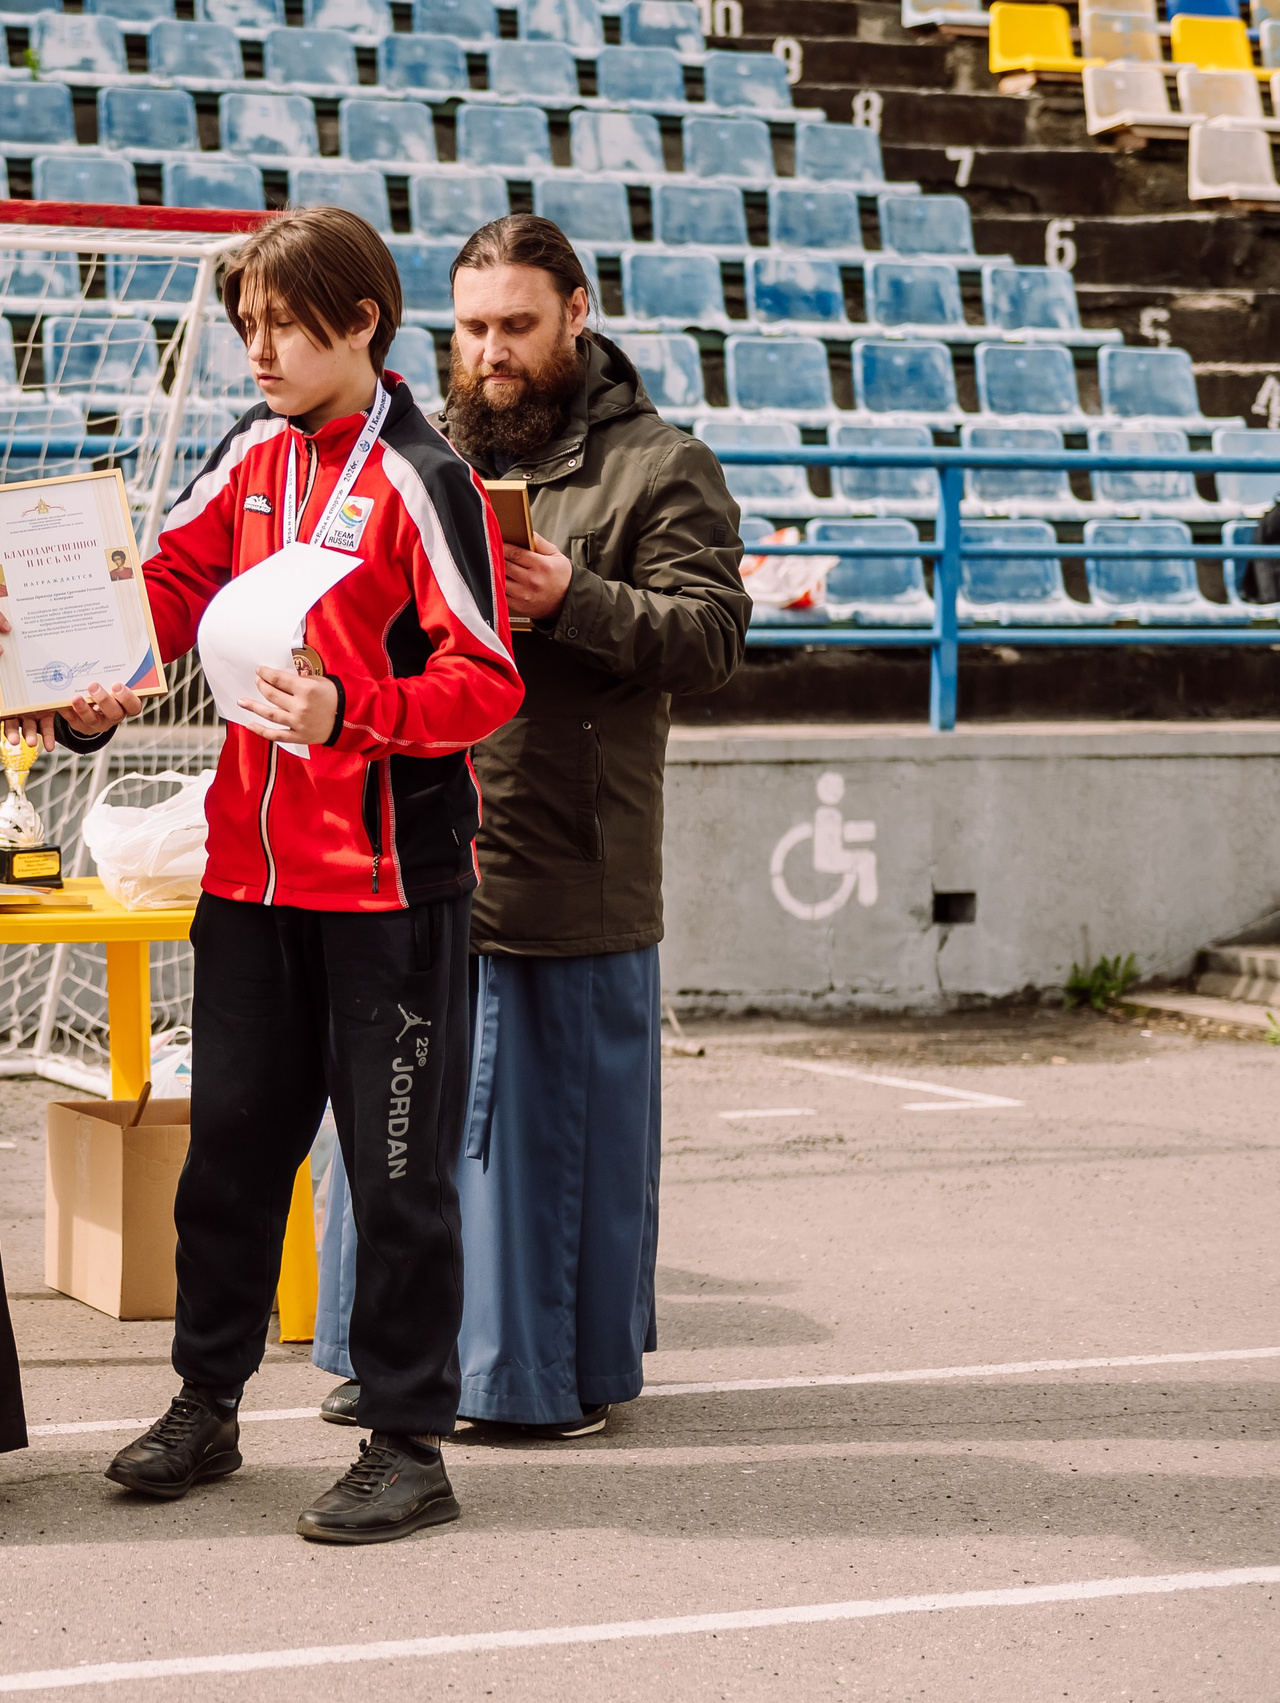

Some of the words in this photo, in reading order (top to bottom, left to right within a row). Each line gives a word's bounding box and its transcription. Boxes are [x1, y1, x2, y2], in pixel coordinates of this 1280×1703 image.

[698, 0, 743, 37] 10
[772, 37, 803, 85] 9
[852, 90, 884, 134] 8
[945, 146, 975, 187] 7
[1045, 218, 1078, 271] 6
[1140, 307, 1172, 348] 5
[4, 539, 98, 559] БЛАГОДАРСТВЕННОЕ
[328, 536, 354, 548] RUSSIA
[334, 529, 354, 540] TEAM
[27, 554, 80, 568] ПИСЬМО
[387, 1057, 414, 1180] JORDAN
